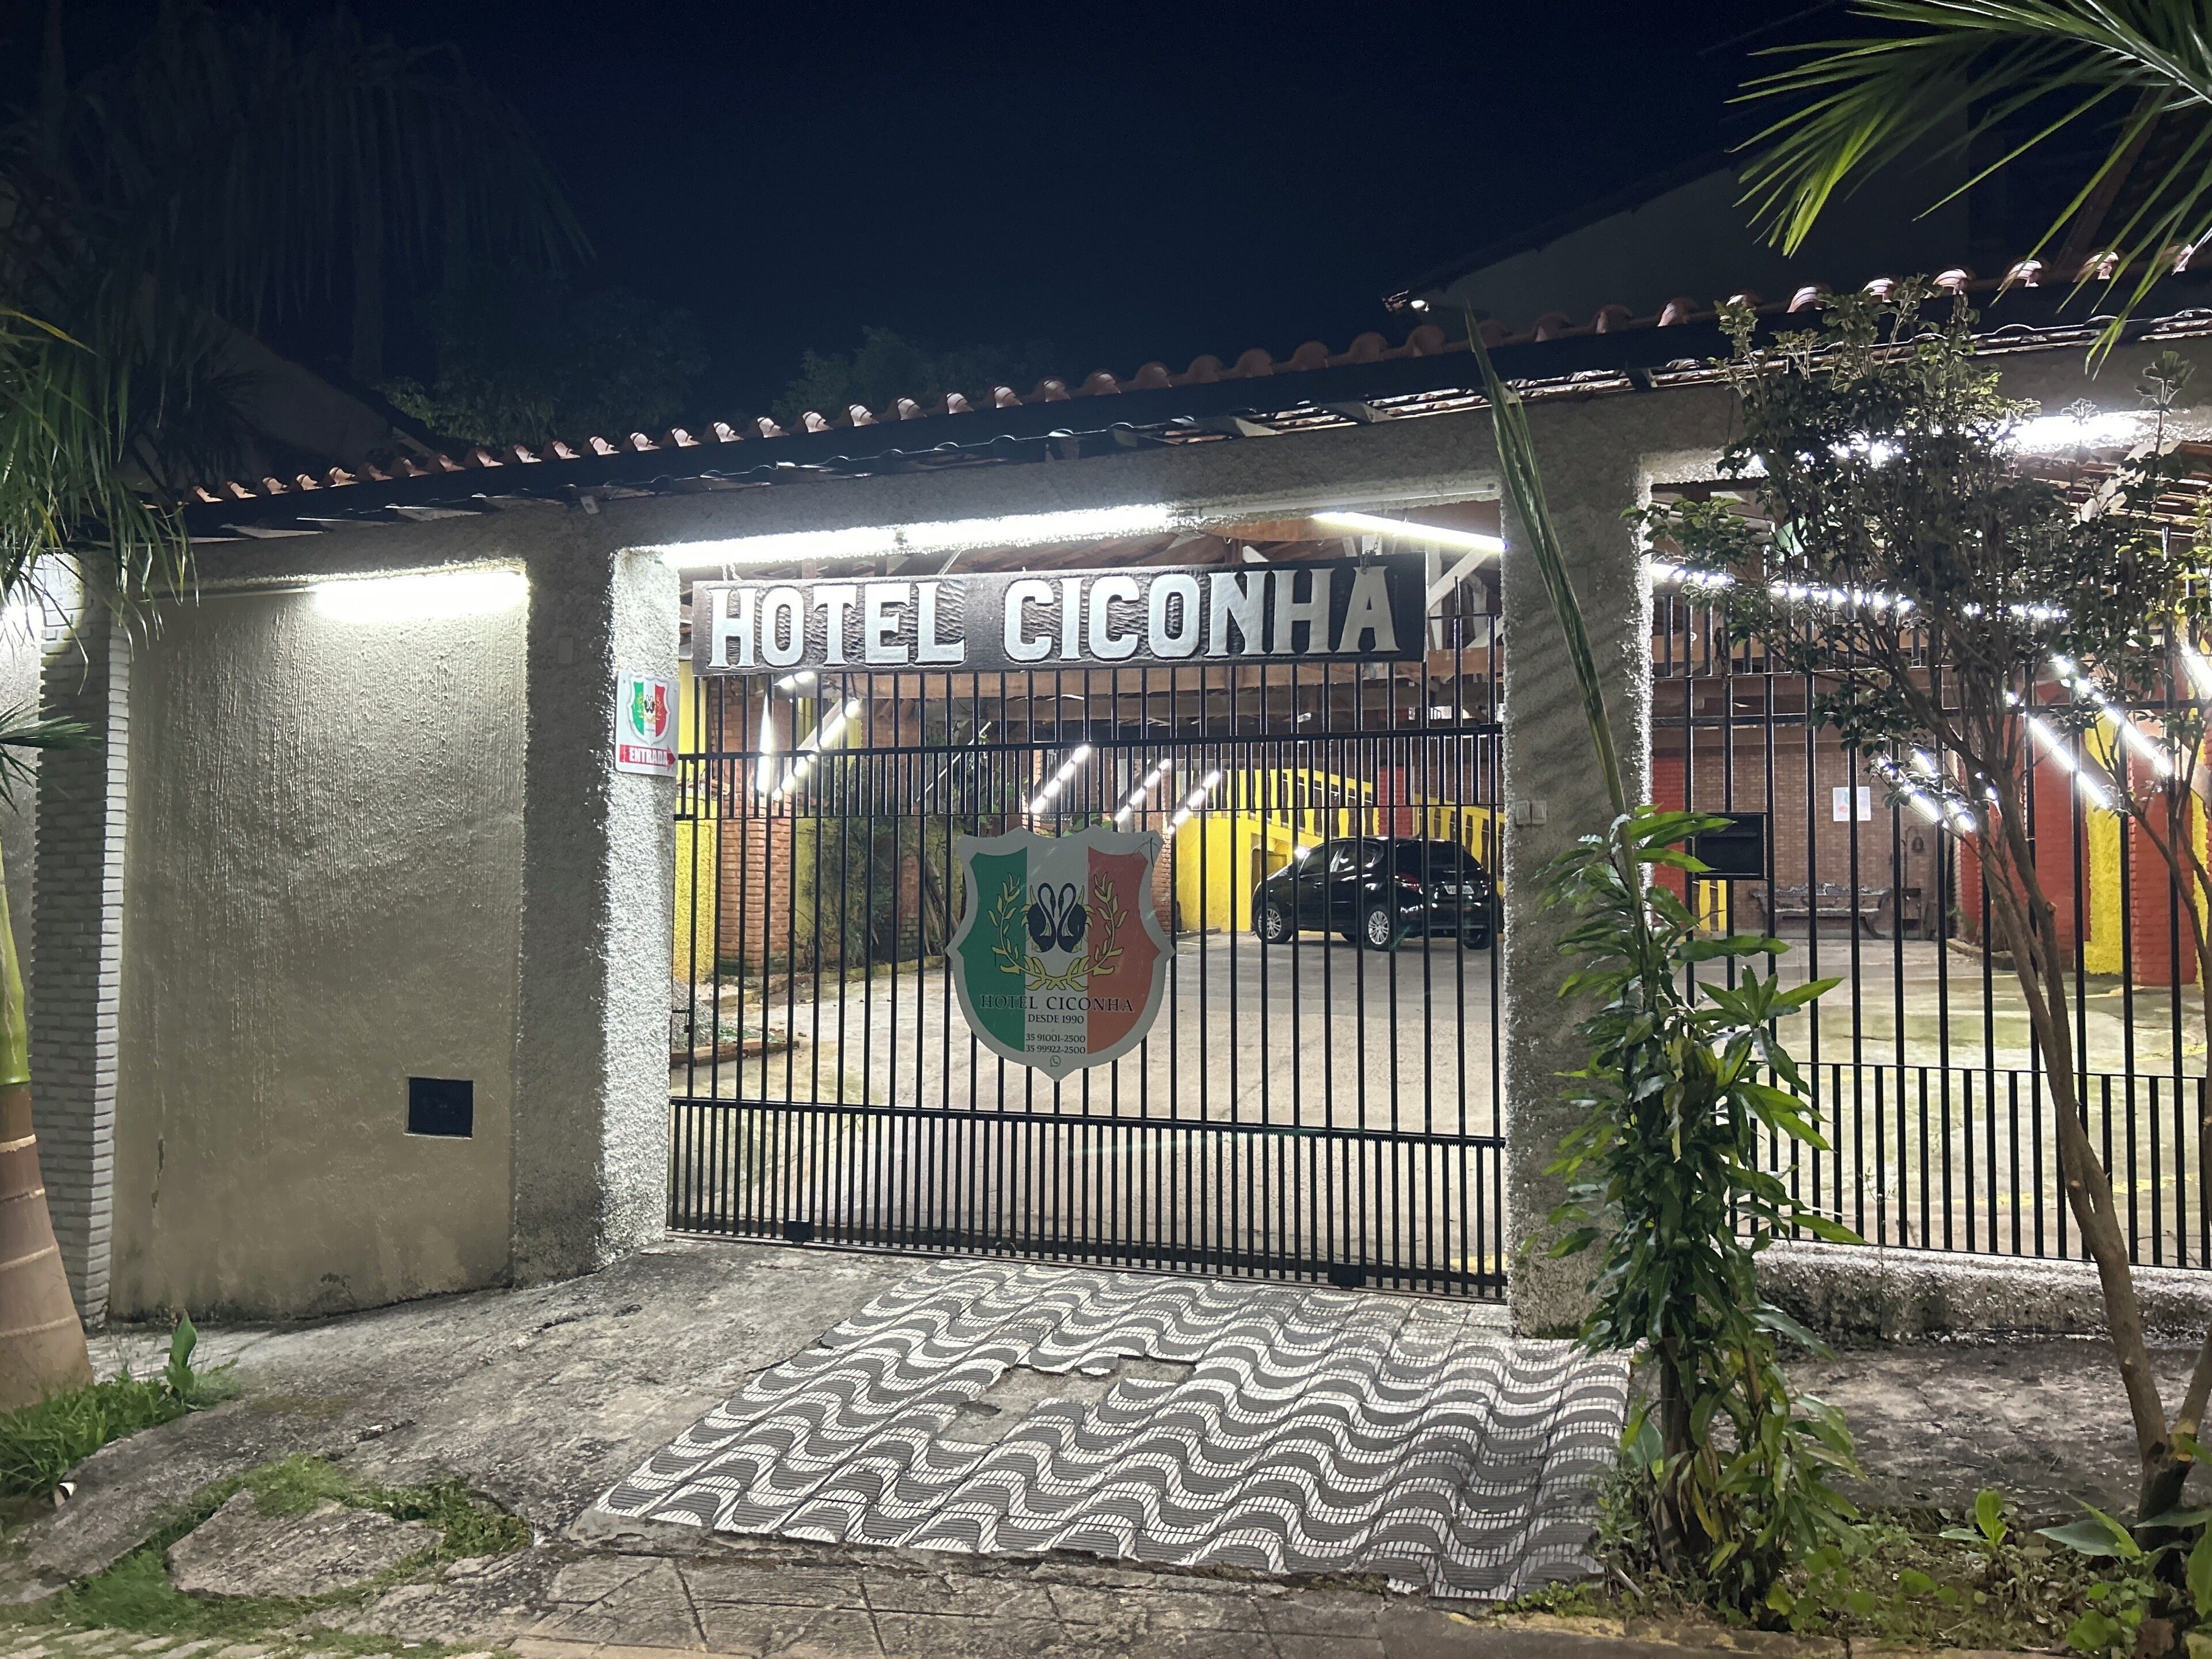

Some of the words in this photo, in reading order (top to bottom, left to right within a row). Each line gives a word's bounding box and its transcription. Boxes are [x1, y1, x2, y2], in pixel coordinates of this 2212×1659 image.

[707, 581, 966, 667] HOTEL
[1003, 566, 1400, 661] CICONHA
[629, 747, 668, 766] ENTRADA
[981, 995, 1037, 1009] HOTEL
[1046, 997, 1134, 1012] CICONHA
[1028, 1014, 1059, 1023] DESDE
[1062, 1015, 1084, 1024] 1990
[1037, 1033, 1086, 1043] 91001-2500
[1025, 1044, 1035, 1052] 35
[1037, 1045, 1086, 1054] 99922-2500
